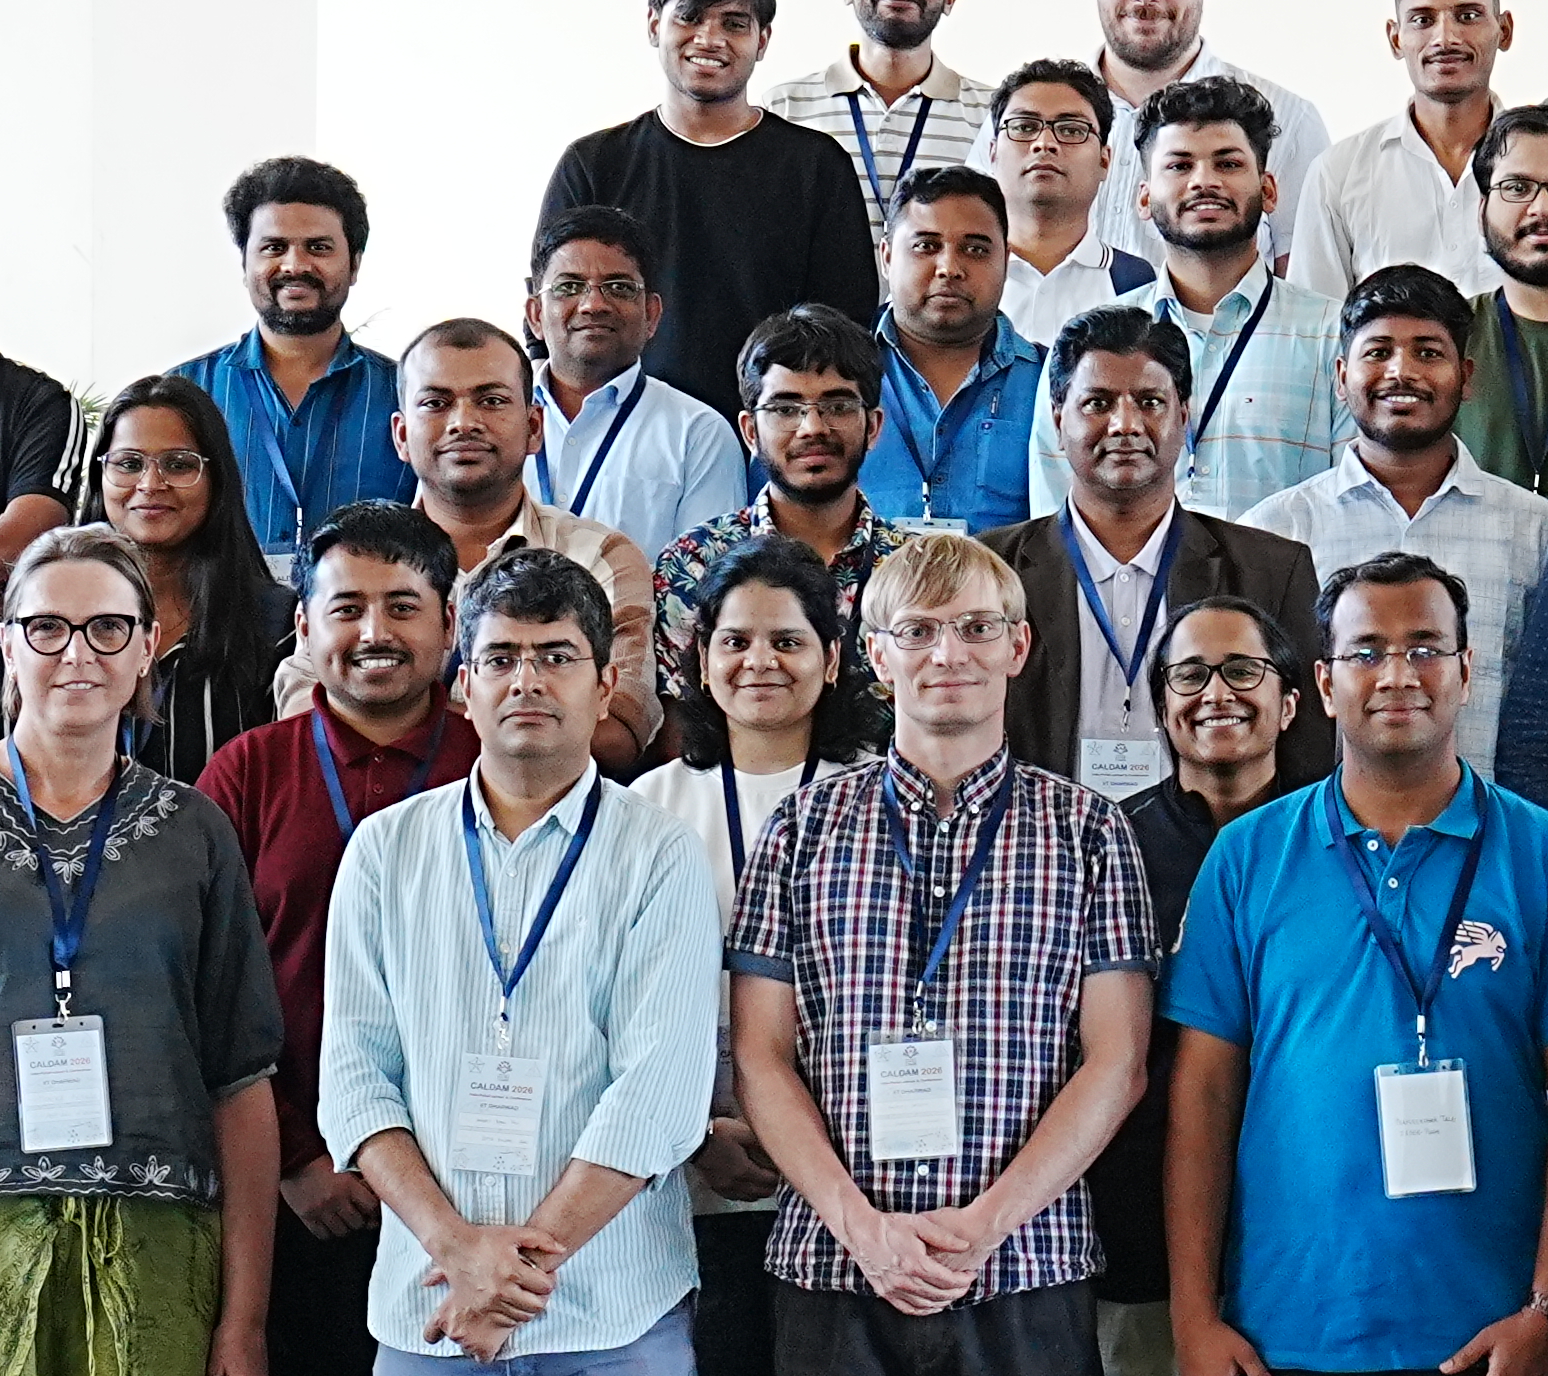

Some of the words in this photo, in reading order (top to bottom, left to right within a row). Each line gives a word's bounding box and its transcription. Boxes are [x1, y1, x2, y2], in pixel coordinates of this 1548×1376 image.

[29, 1059, 68, 1069] CALDAM
[70, 1057, 91, 1066] 2026
[880, 1068, 919, 1078] CALDAM
[921, 1067, 943, 1076] 2026
[470, 1081, 510, 1092] CALDAM
[511, 1085, 533, 1095] 2026
